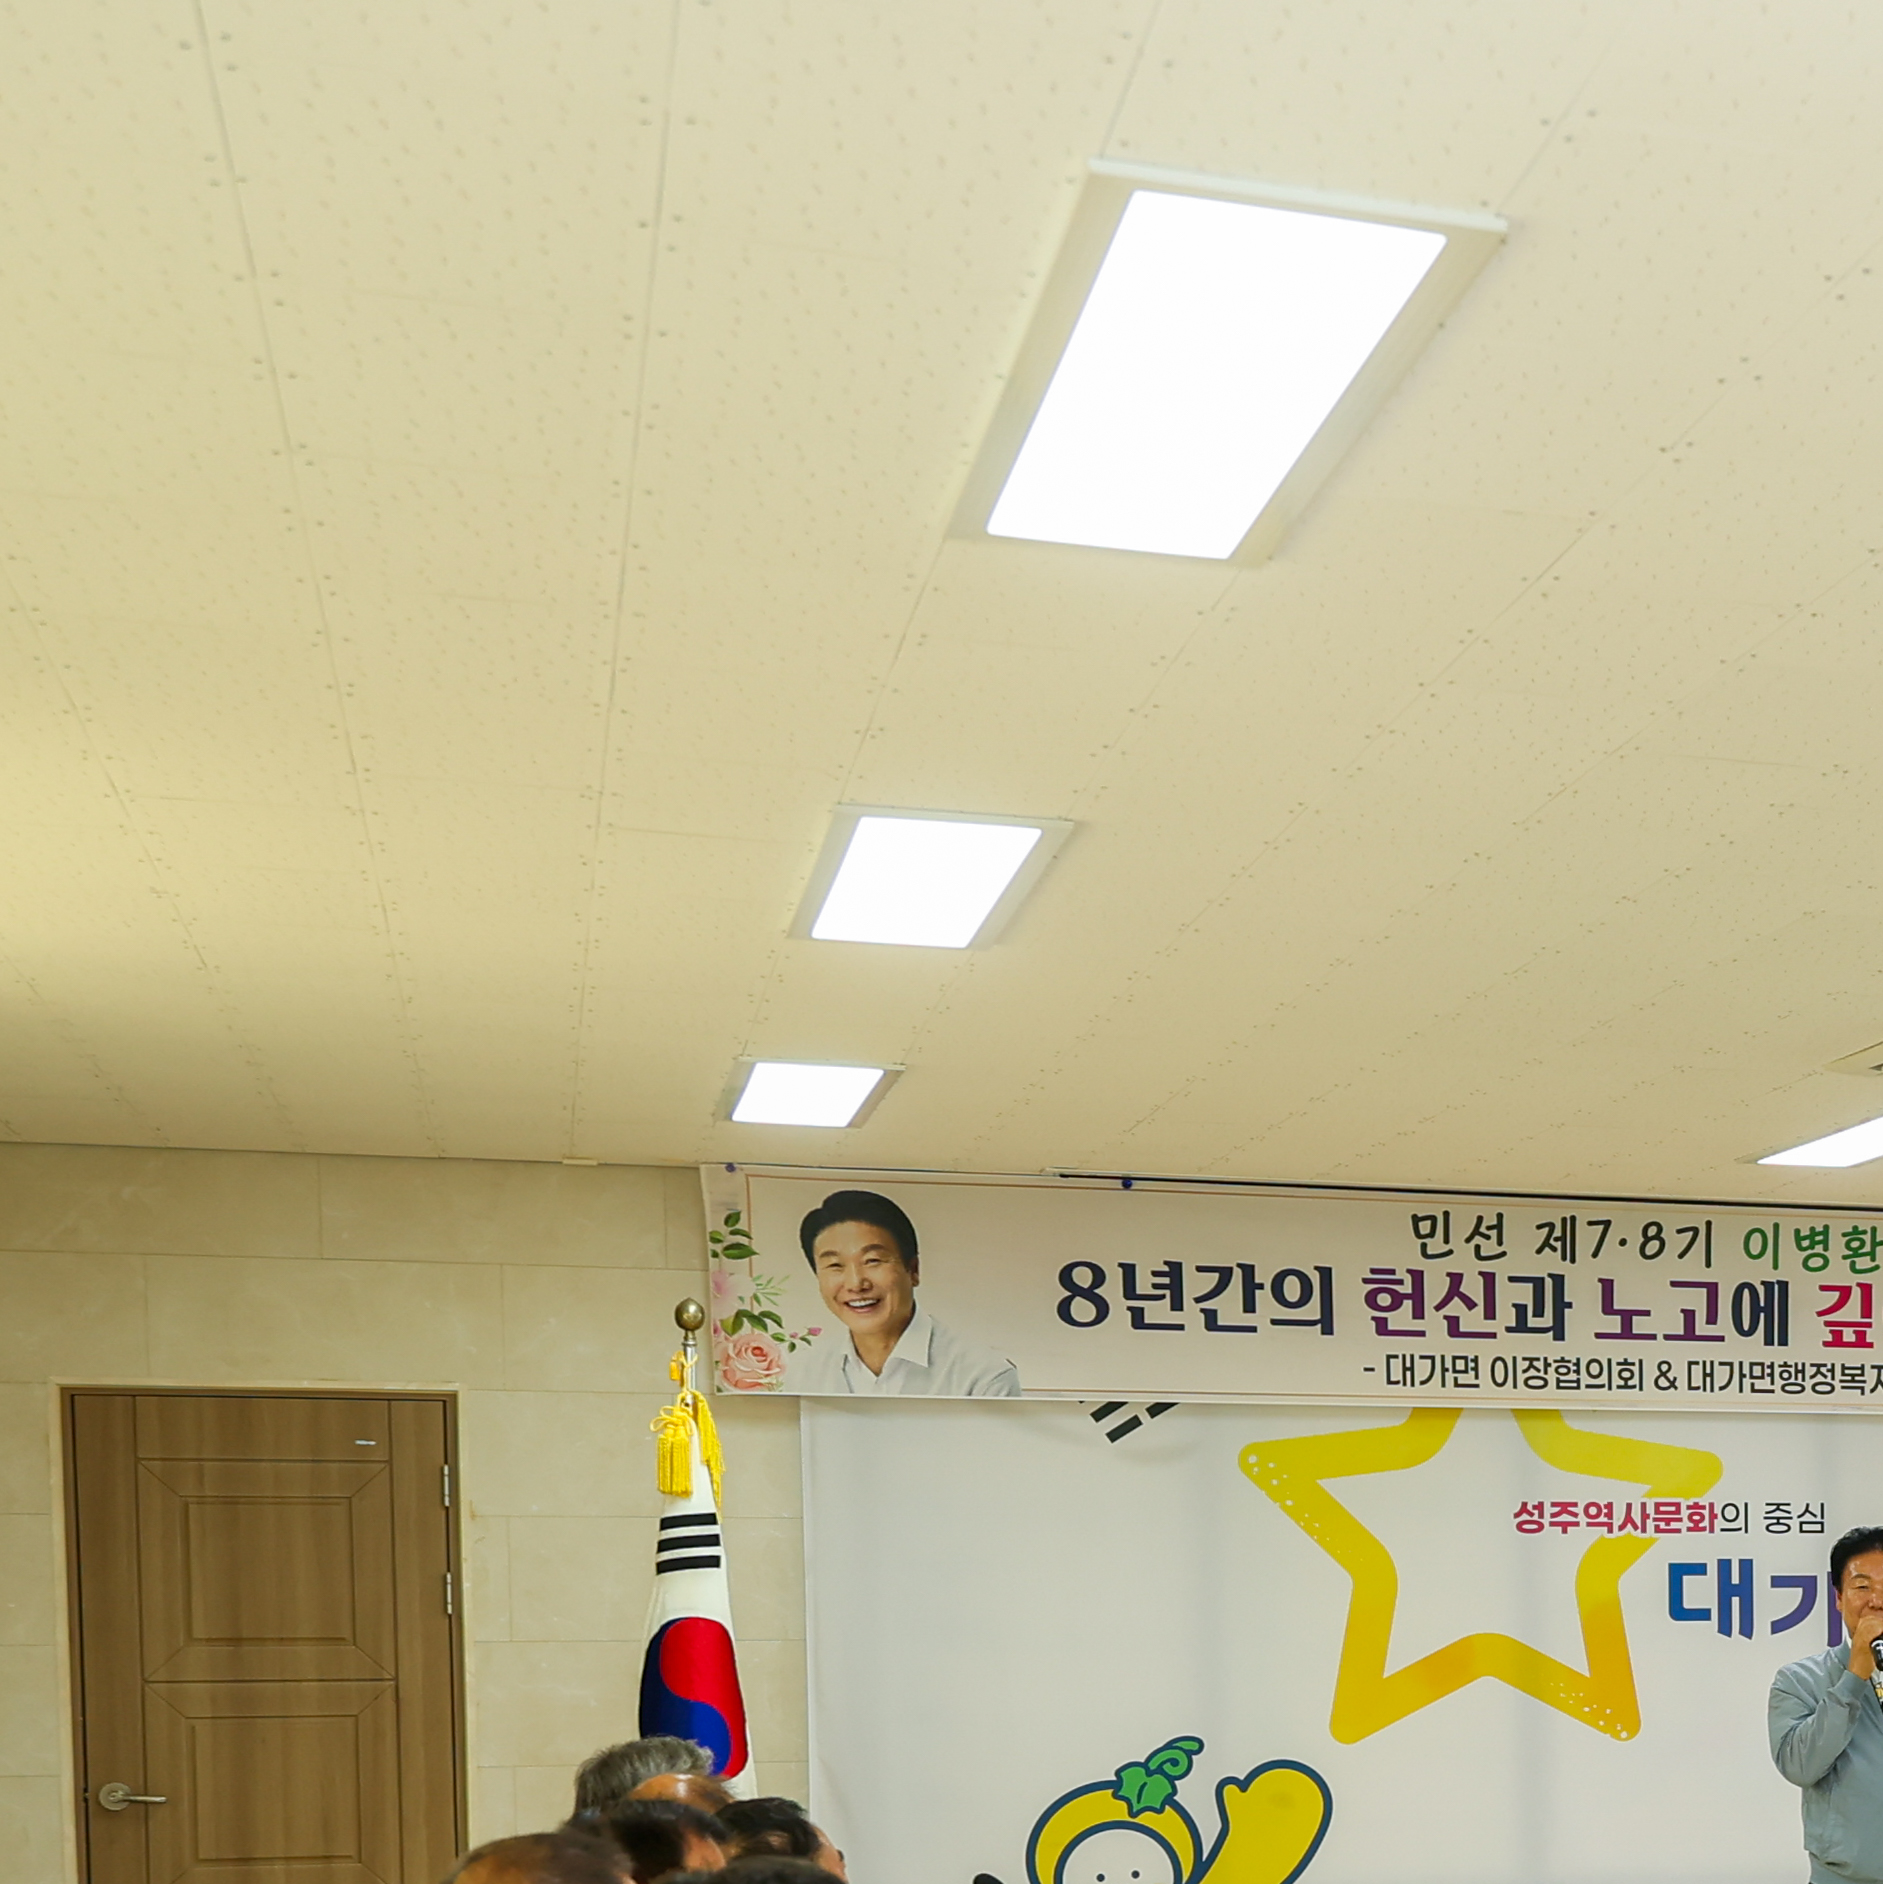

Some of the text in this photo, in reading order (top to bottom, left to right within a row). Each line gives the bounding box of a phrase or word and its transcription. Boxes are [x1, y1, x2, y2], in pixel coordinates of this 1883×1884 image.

[1411, 1210, 1509, 1262] 민선
[1056, 1260, 1335, 1337] 8년간의
[1362, 1266, 1575, 1342] 헌신과
[1592, 1273, 1790, 1346] 노고에
[1385, 1352, 1481, 1390] 대가면
[1490, 1353, 1645, 1394] 이장협의회
[1513, 1500, 1827, 1536] 성주역사문화의 중심
